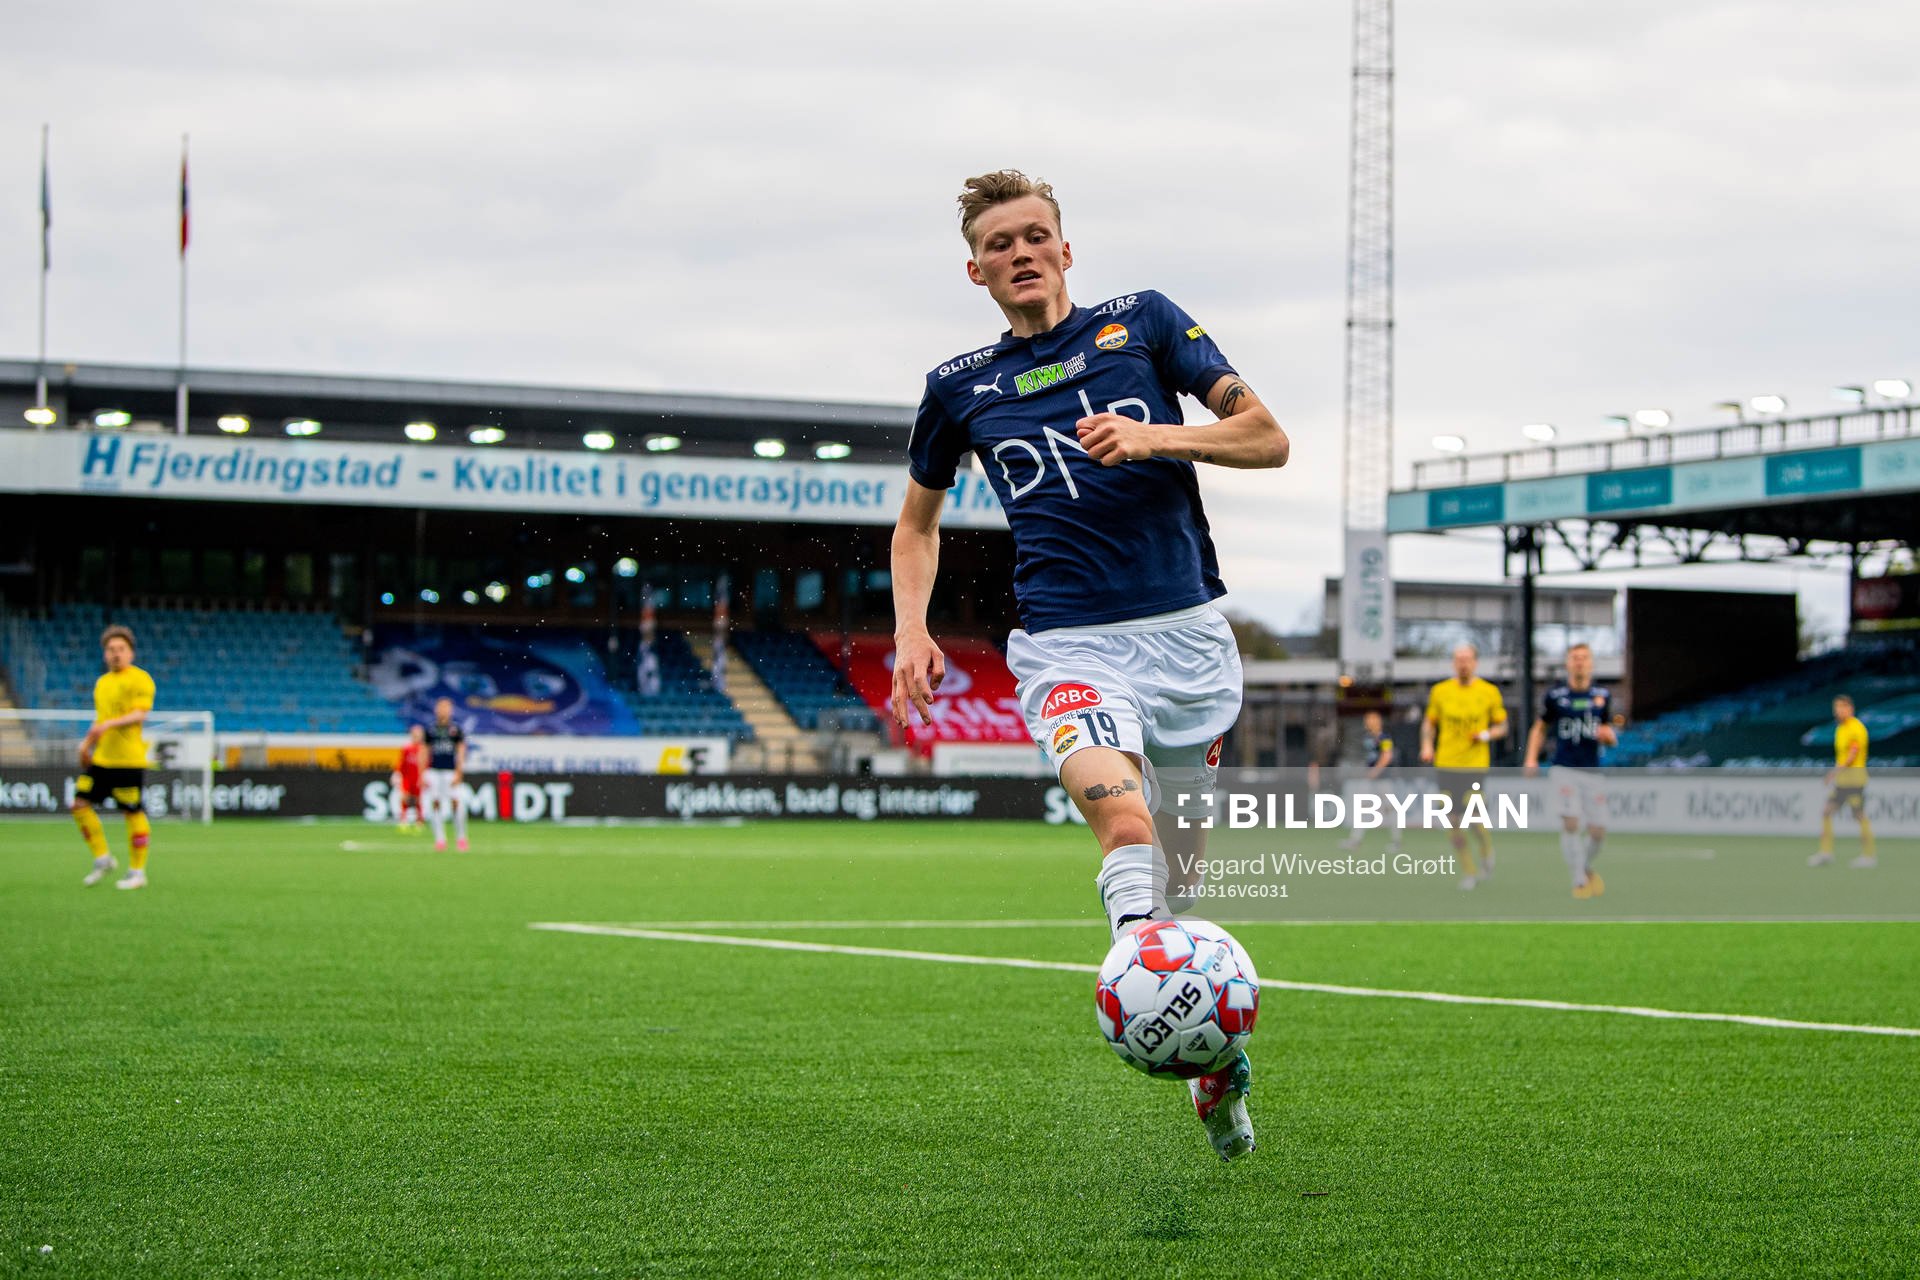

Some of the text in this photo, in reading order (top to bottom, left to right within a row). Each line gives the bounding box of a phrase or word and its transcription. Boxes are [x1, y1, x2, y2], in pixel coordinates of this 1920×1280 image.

[1014, 362, 1067, 396] KIWI
[82, 436, 121, 477] H
[129, 443, 402, 492] Fjerdingstad
[453, 457, 601, 494] Kvalitet
[617, 460, 626, 494] i
[641, 468, 886, 510] generasjoner
[1044, 689, 1101, 720] ARBO
[1078, 711, 1121, 747] 19
[665, 782, 783, 818] Kjøkken,
[786, 782, 838, 815] bad
[842, 787, 876, 821] og
[1135, 982, 1202, 1055] SELECT
